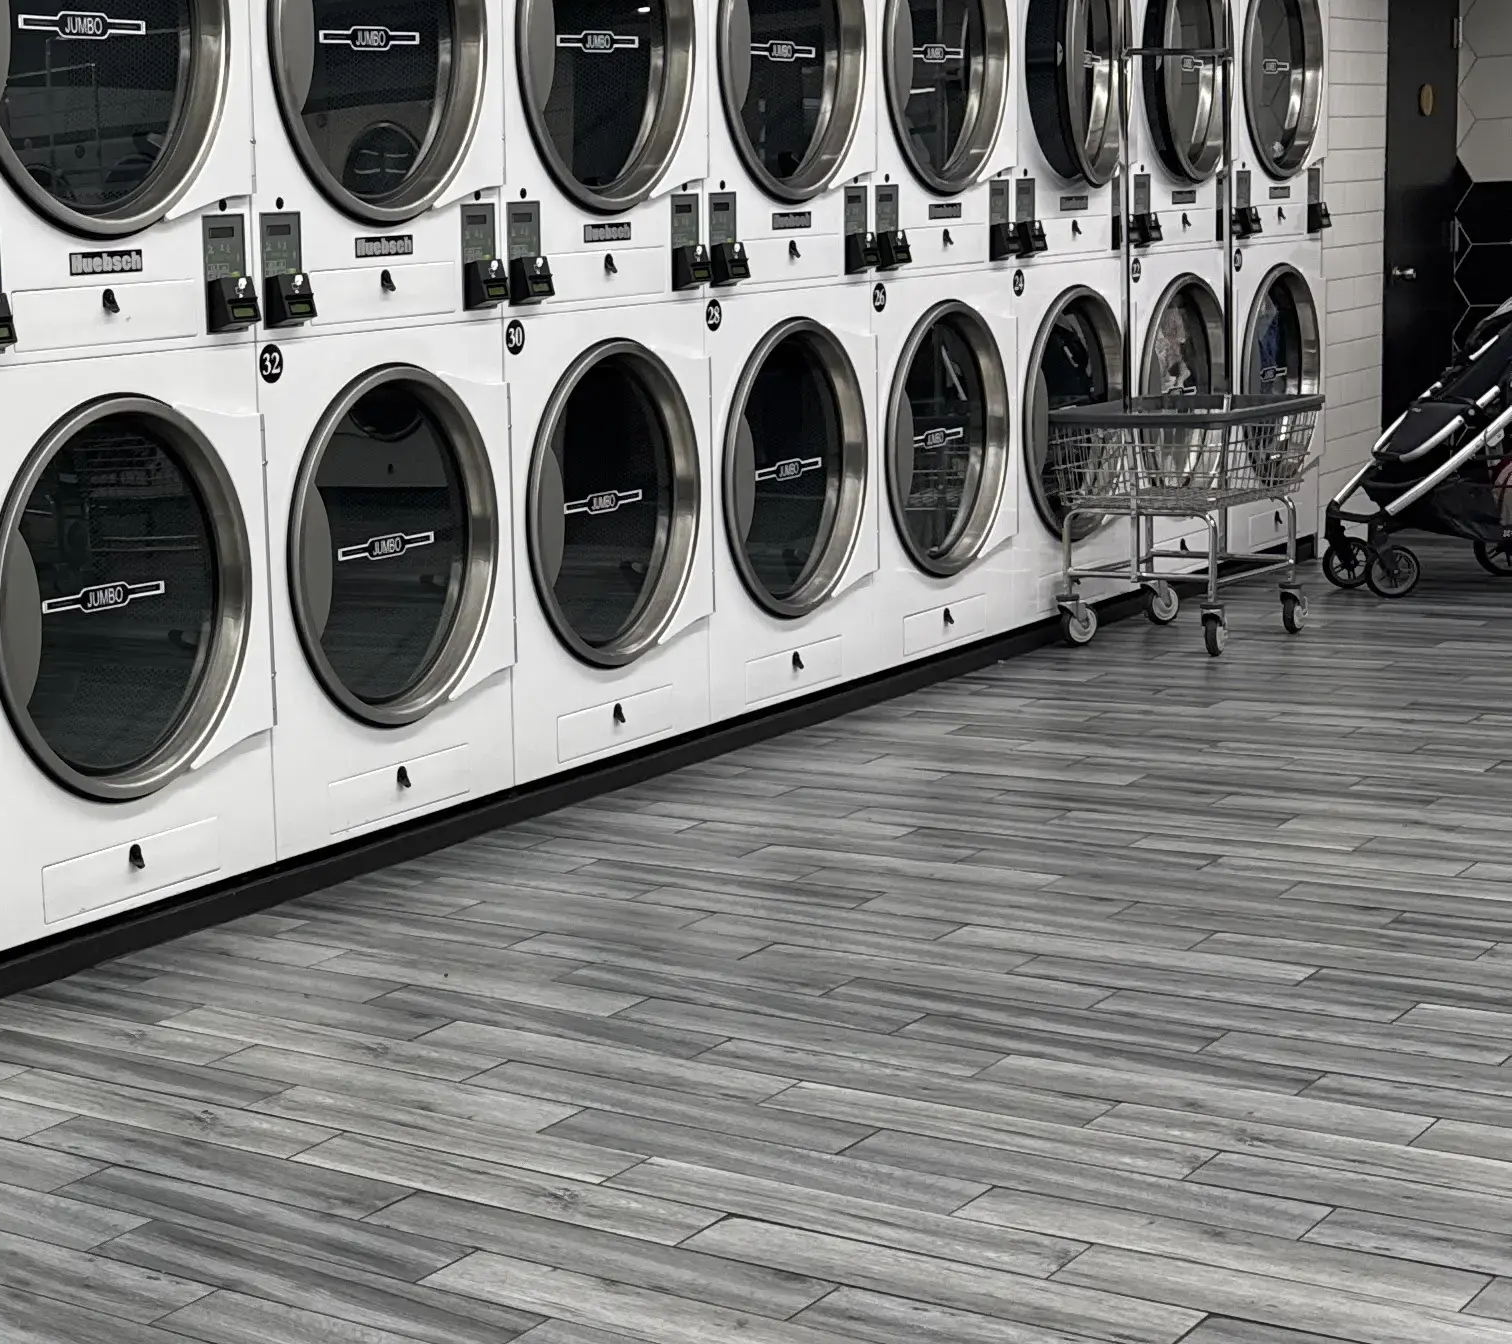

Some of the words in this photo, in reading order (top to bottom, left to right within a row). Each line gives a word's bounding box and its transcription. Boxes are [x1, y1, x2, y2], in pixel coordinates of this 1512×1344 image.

[65, 16, 102, 34] JUMBO
[356, 31, 386, 46] JUMBO
[357, 236, 412, 256] Huebsch
[71, 251, 141, 274] Huebsch
[874, 288, 884, 306] 26
[708, 306, 719, 324] 28
[508, 327, 523, 348] 30
[262, 352, 281, 375] 32
[372, 537, 401, 556] JUMBO
[87, 586, 123, 607] JUMBO
